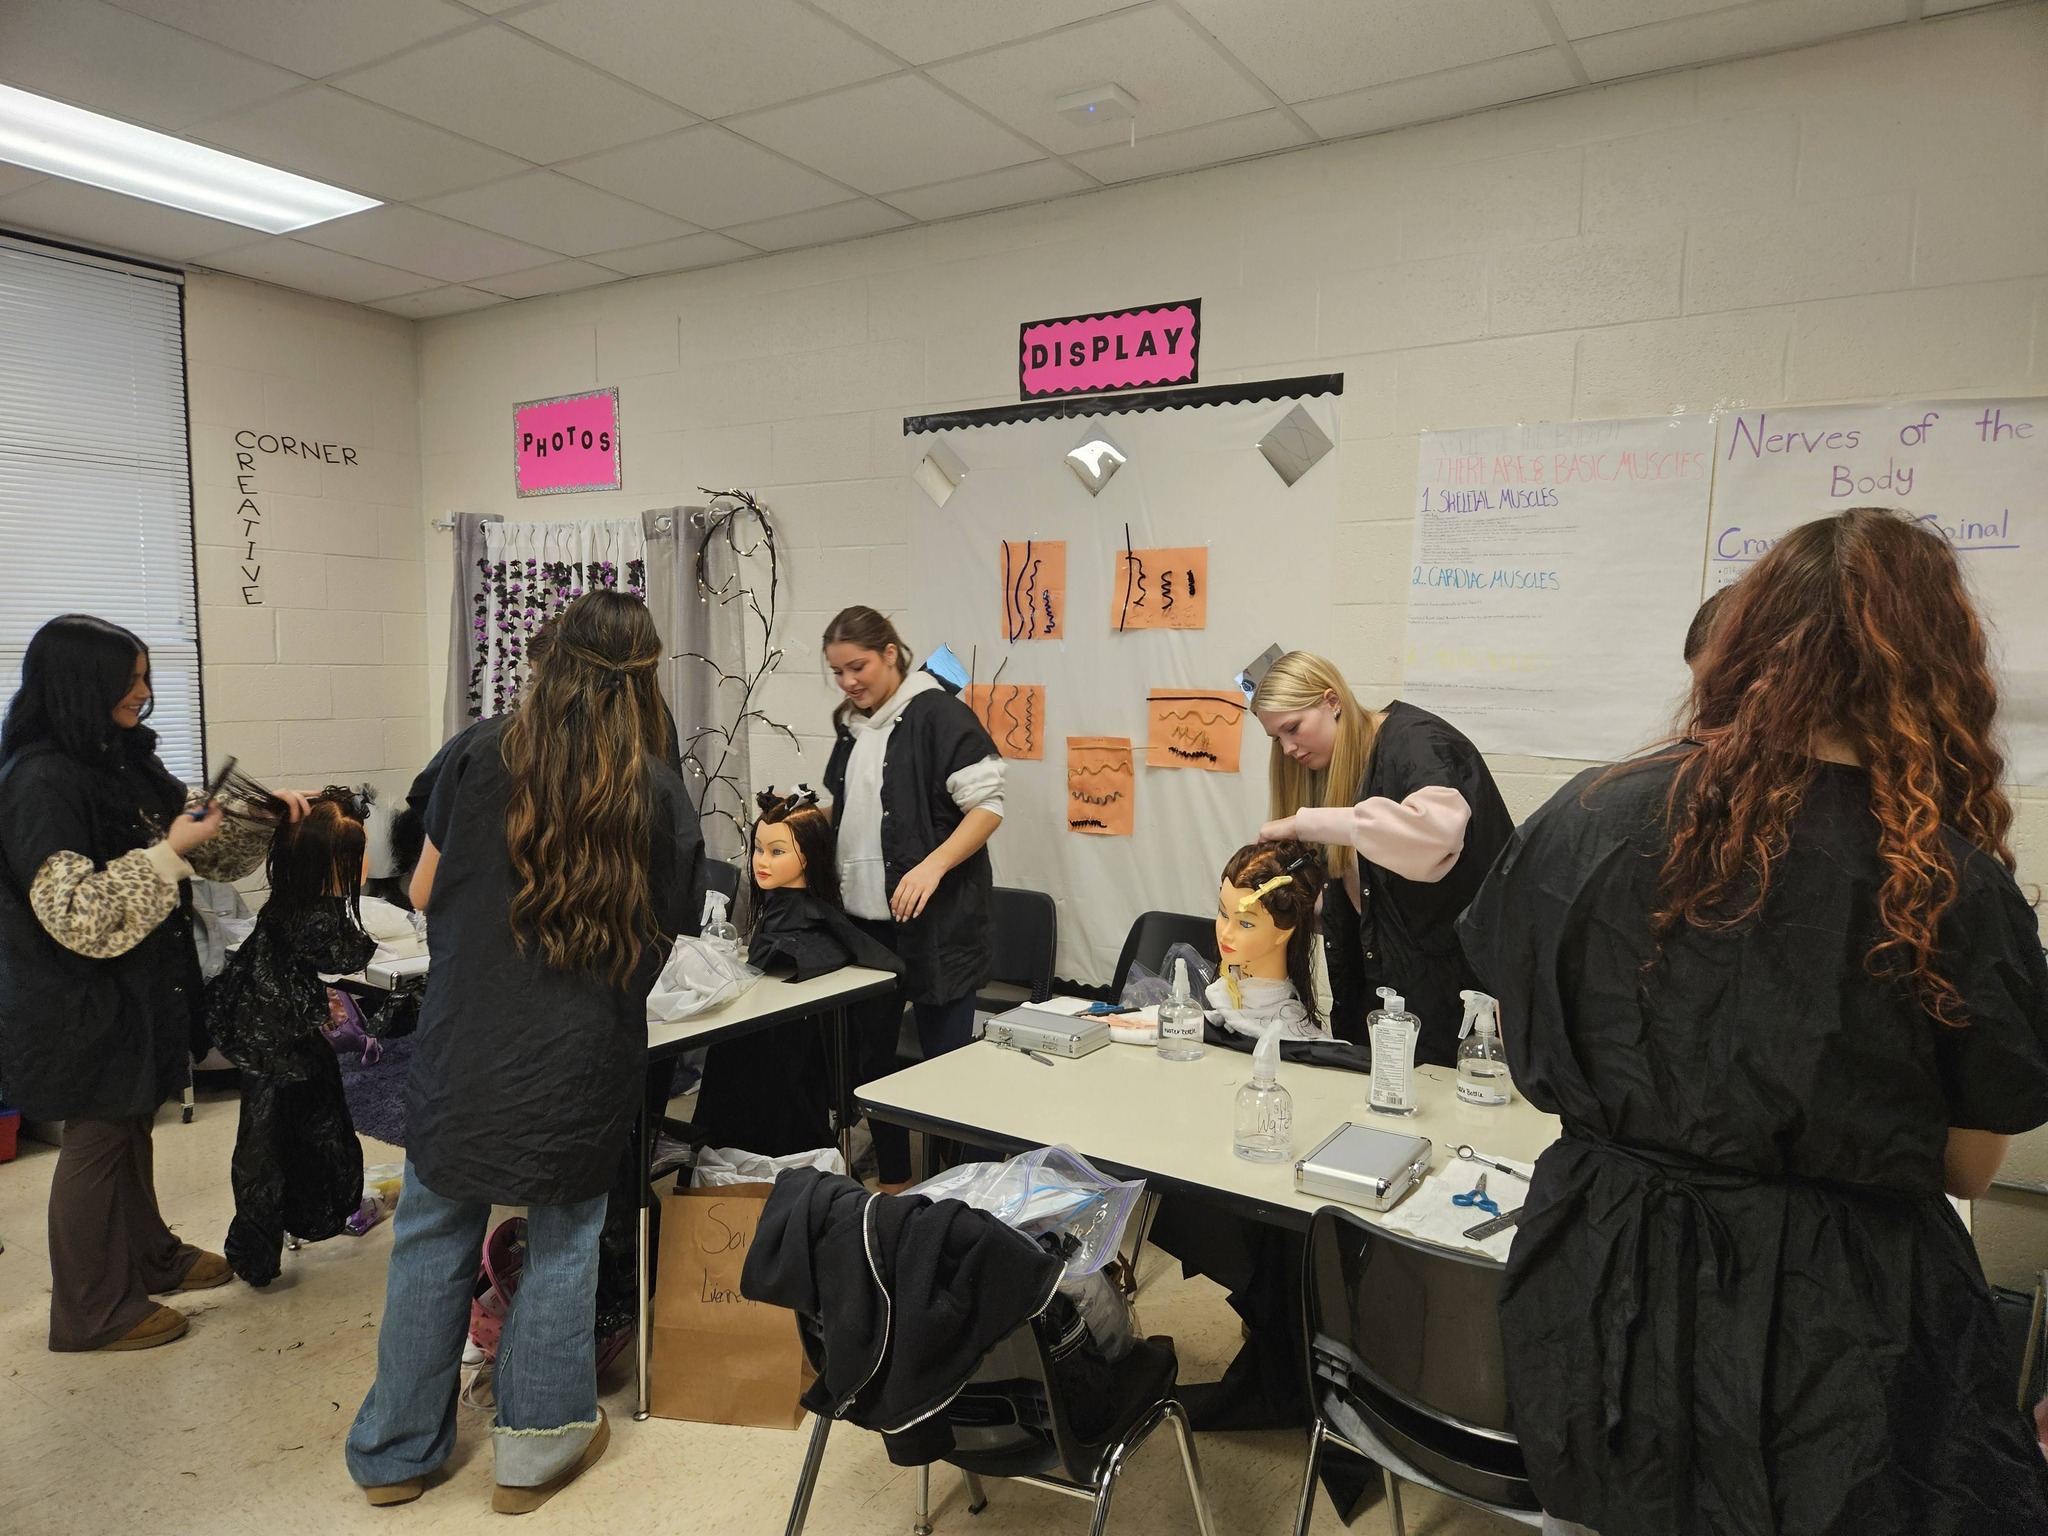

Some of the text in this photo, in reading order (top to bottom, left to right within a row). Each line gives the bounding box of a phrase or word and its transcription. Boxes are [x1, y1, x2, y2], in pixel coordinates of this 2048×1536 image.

[1031, 327, 1184, 370] DISPLAY
[235, 430, 358, 466] CORNER
[523, 425, 611, 458] PHOTOS
[1728, 408, 2034, 461] Nerves of the
[1435, 454, 1488, 485] THERE
[1554, 453, 1606, 485] BASIC
[1830, 456, 1914, 498] Body
[1421, 487, 1436, 513] 1.
[1499, 487, 1560, 510] MUSCLES
[1412, 565, 1560, 591] 2. CARDIAC MUSCLES
